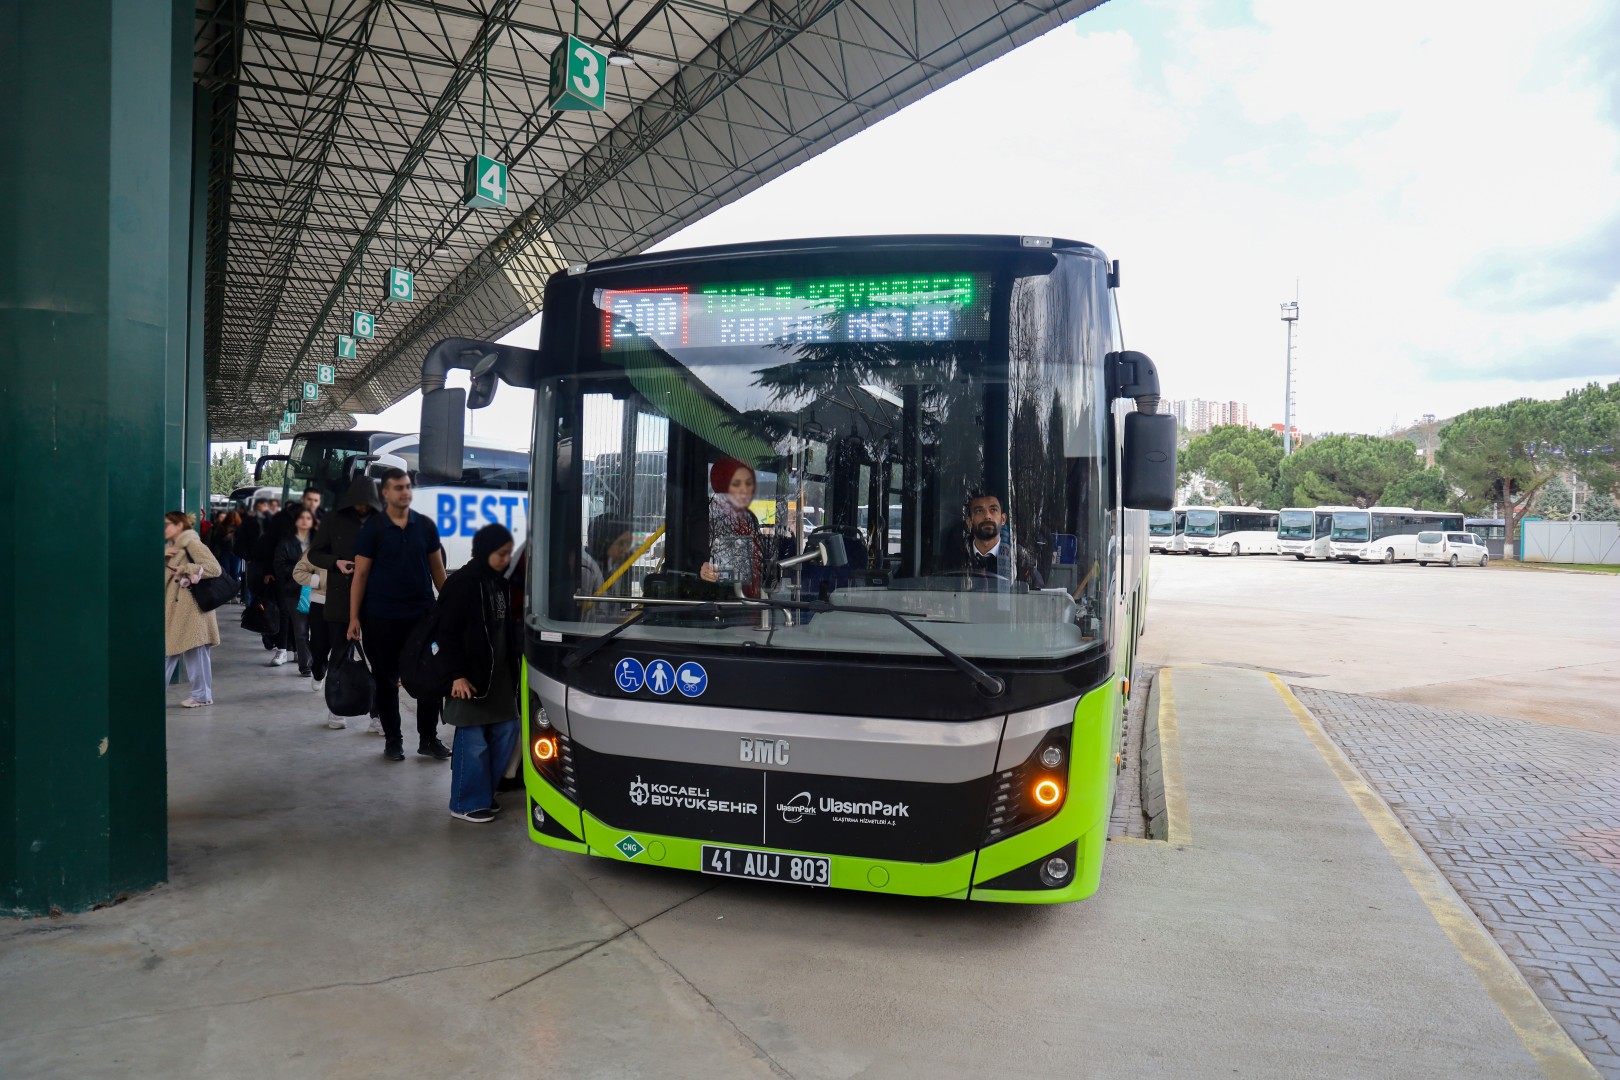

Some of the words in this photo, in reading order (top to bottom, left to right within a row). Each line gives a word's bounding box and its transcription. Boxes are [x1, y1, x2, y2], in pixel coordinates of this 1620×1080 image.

[551, 47, 565, 97] 3
[573, 47, 600, 98] 3
[480, 165, 503, 200] 4
[393, 272, 410, 297] 5
[356, 315, 371, 335] 6
[613, 297, 677, 338] 200
[721, 316, 830, 343] KARTAL
[848, 311, 949, 339] METRO
[341, 337, 354, 355] 7
[320, 366, 332, 382] 8
[305, 384, 316, 398] 9
[289, 401, 300, 412] 10
[280, 422, 289, 432] 12
[286, 413, 295, 423] 11
[739, 737, 790, 766] BMC
[622, 842, 637, 852] CNG
[711, 849, 731, 872] 41
[743, 853, 780, 878] AUJ
[790, 858, 828, 883] 803
